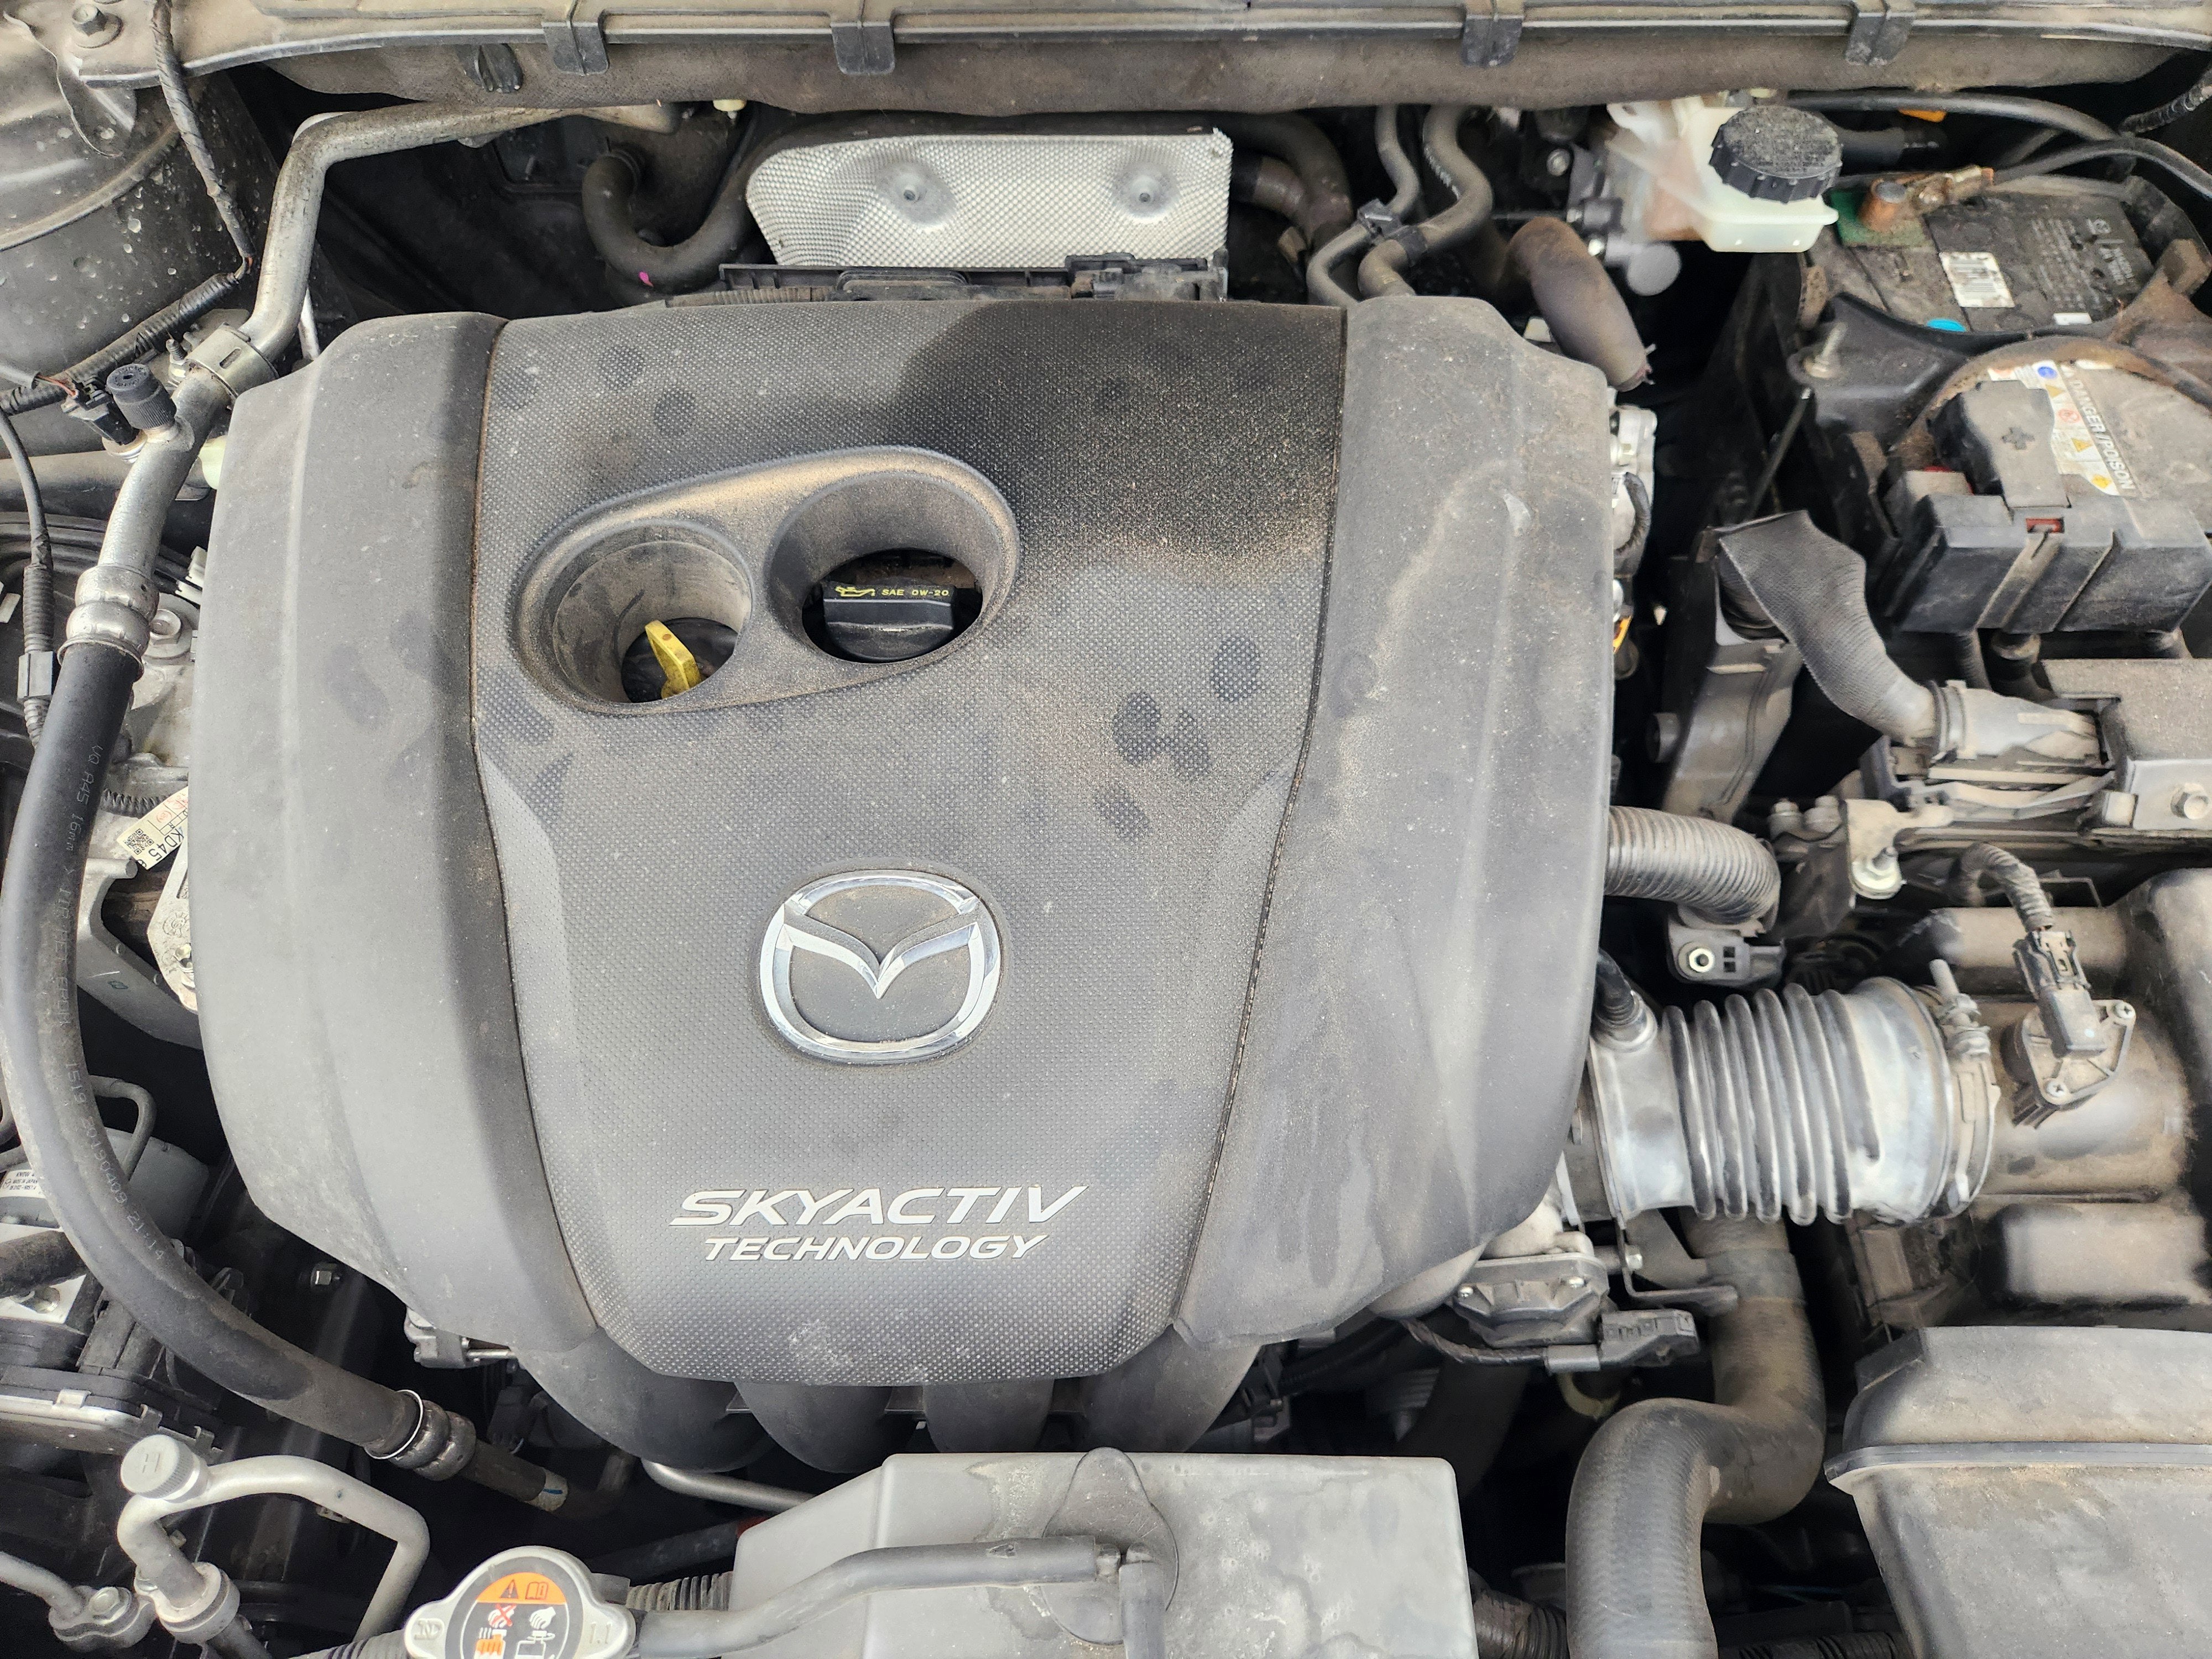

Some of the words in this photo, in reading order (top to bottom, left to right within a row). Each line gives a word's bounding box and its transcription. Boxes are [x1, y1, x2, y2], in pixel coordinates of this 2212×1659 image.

[2069, 379, 2106, 433] DANGER
[148, 828, 184, 861] KD45
[66, 1062, 86, 1103] 1519
[668, 1185, 1089, 1226] SKYACTIV
[704, 1234, 1049, 1261] TECHNOLOGY
